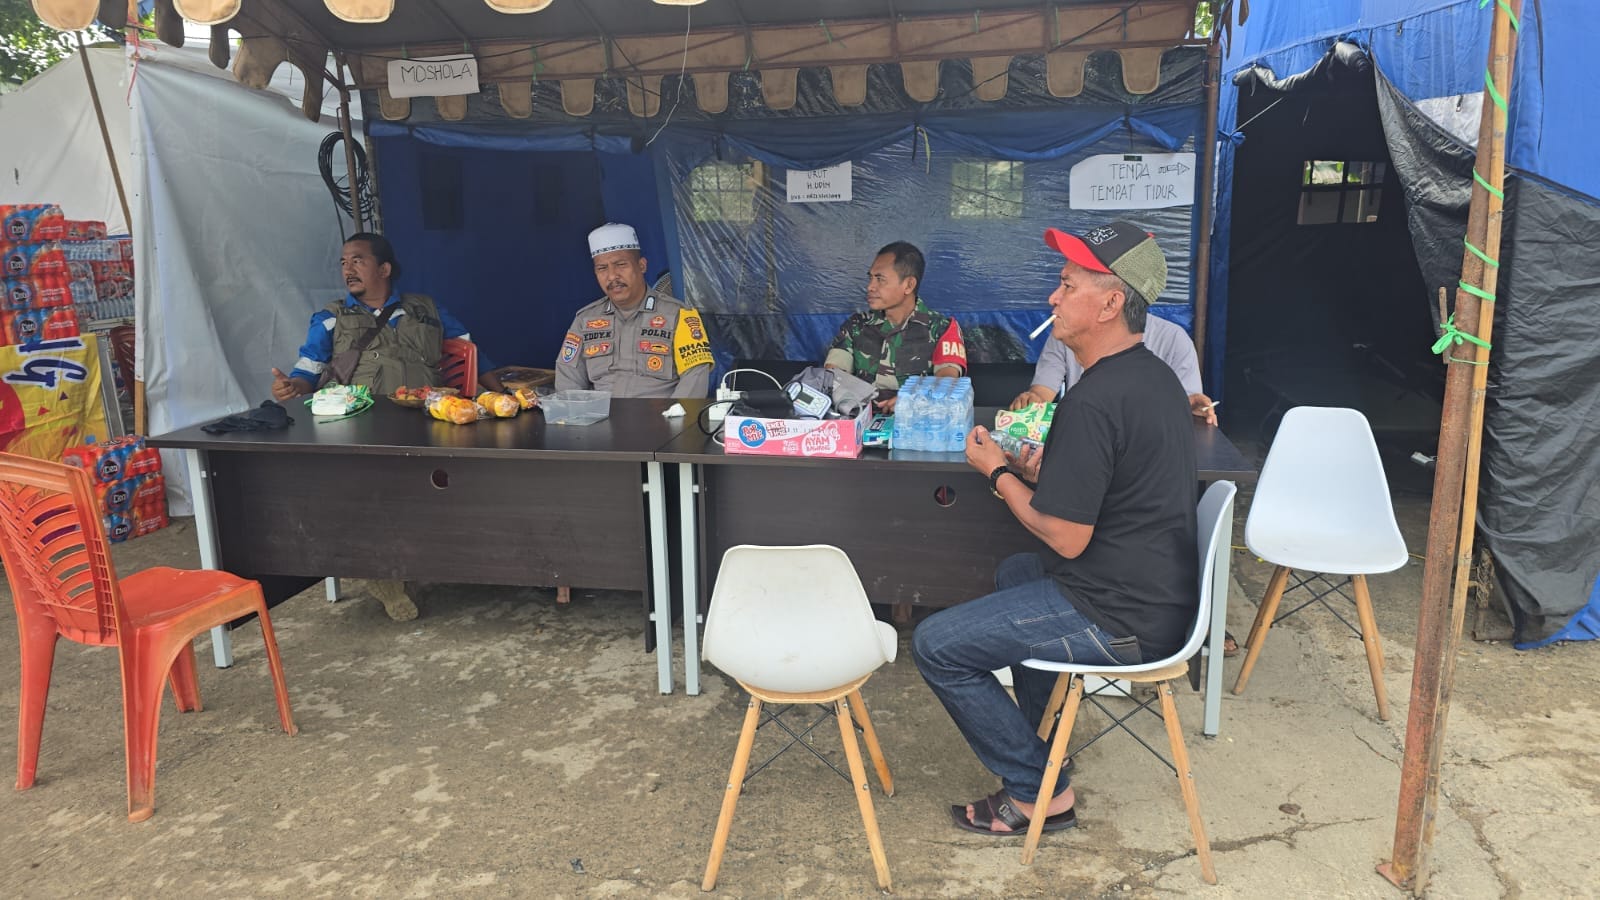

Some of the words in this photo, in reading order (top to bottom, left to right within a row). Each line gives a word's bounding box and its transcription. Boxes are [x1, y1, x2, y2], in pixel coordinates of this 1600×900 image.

[1110, 163, 1150, 180] TENDA
[1090, 184, 1135, 200] TEMPAT
[1144, 184, 1177, 200] TIDUR
[641, 329, 671, 339] POLRI
[805, 435, 830, 446] AYAM
